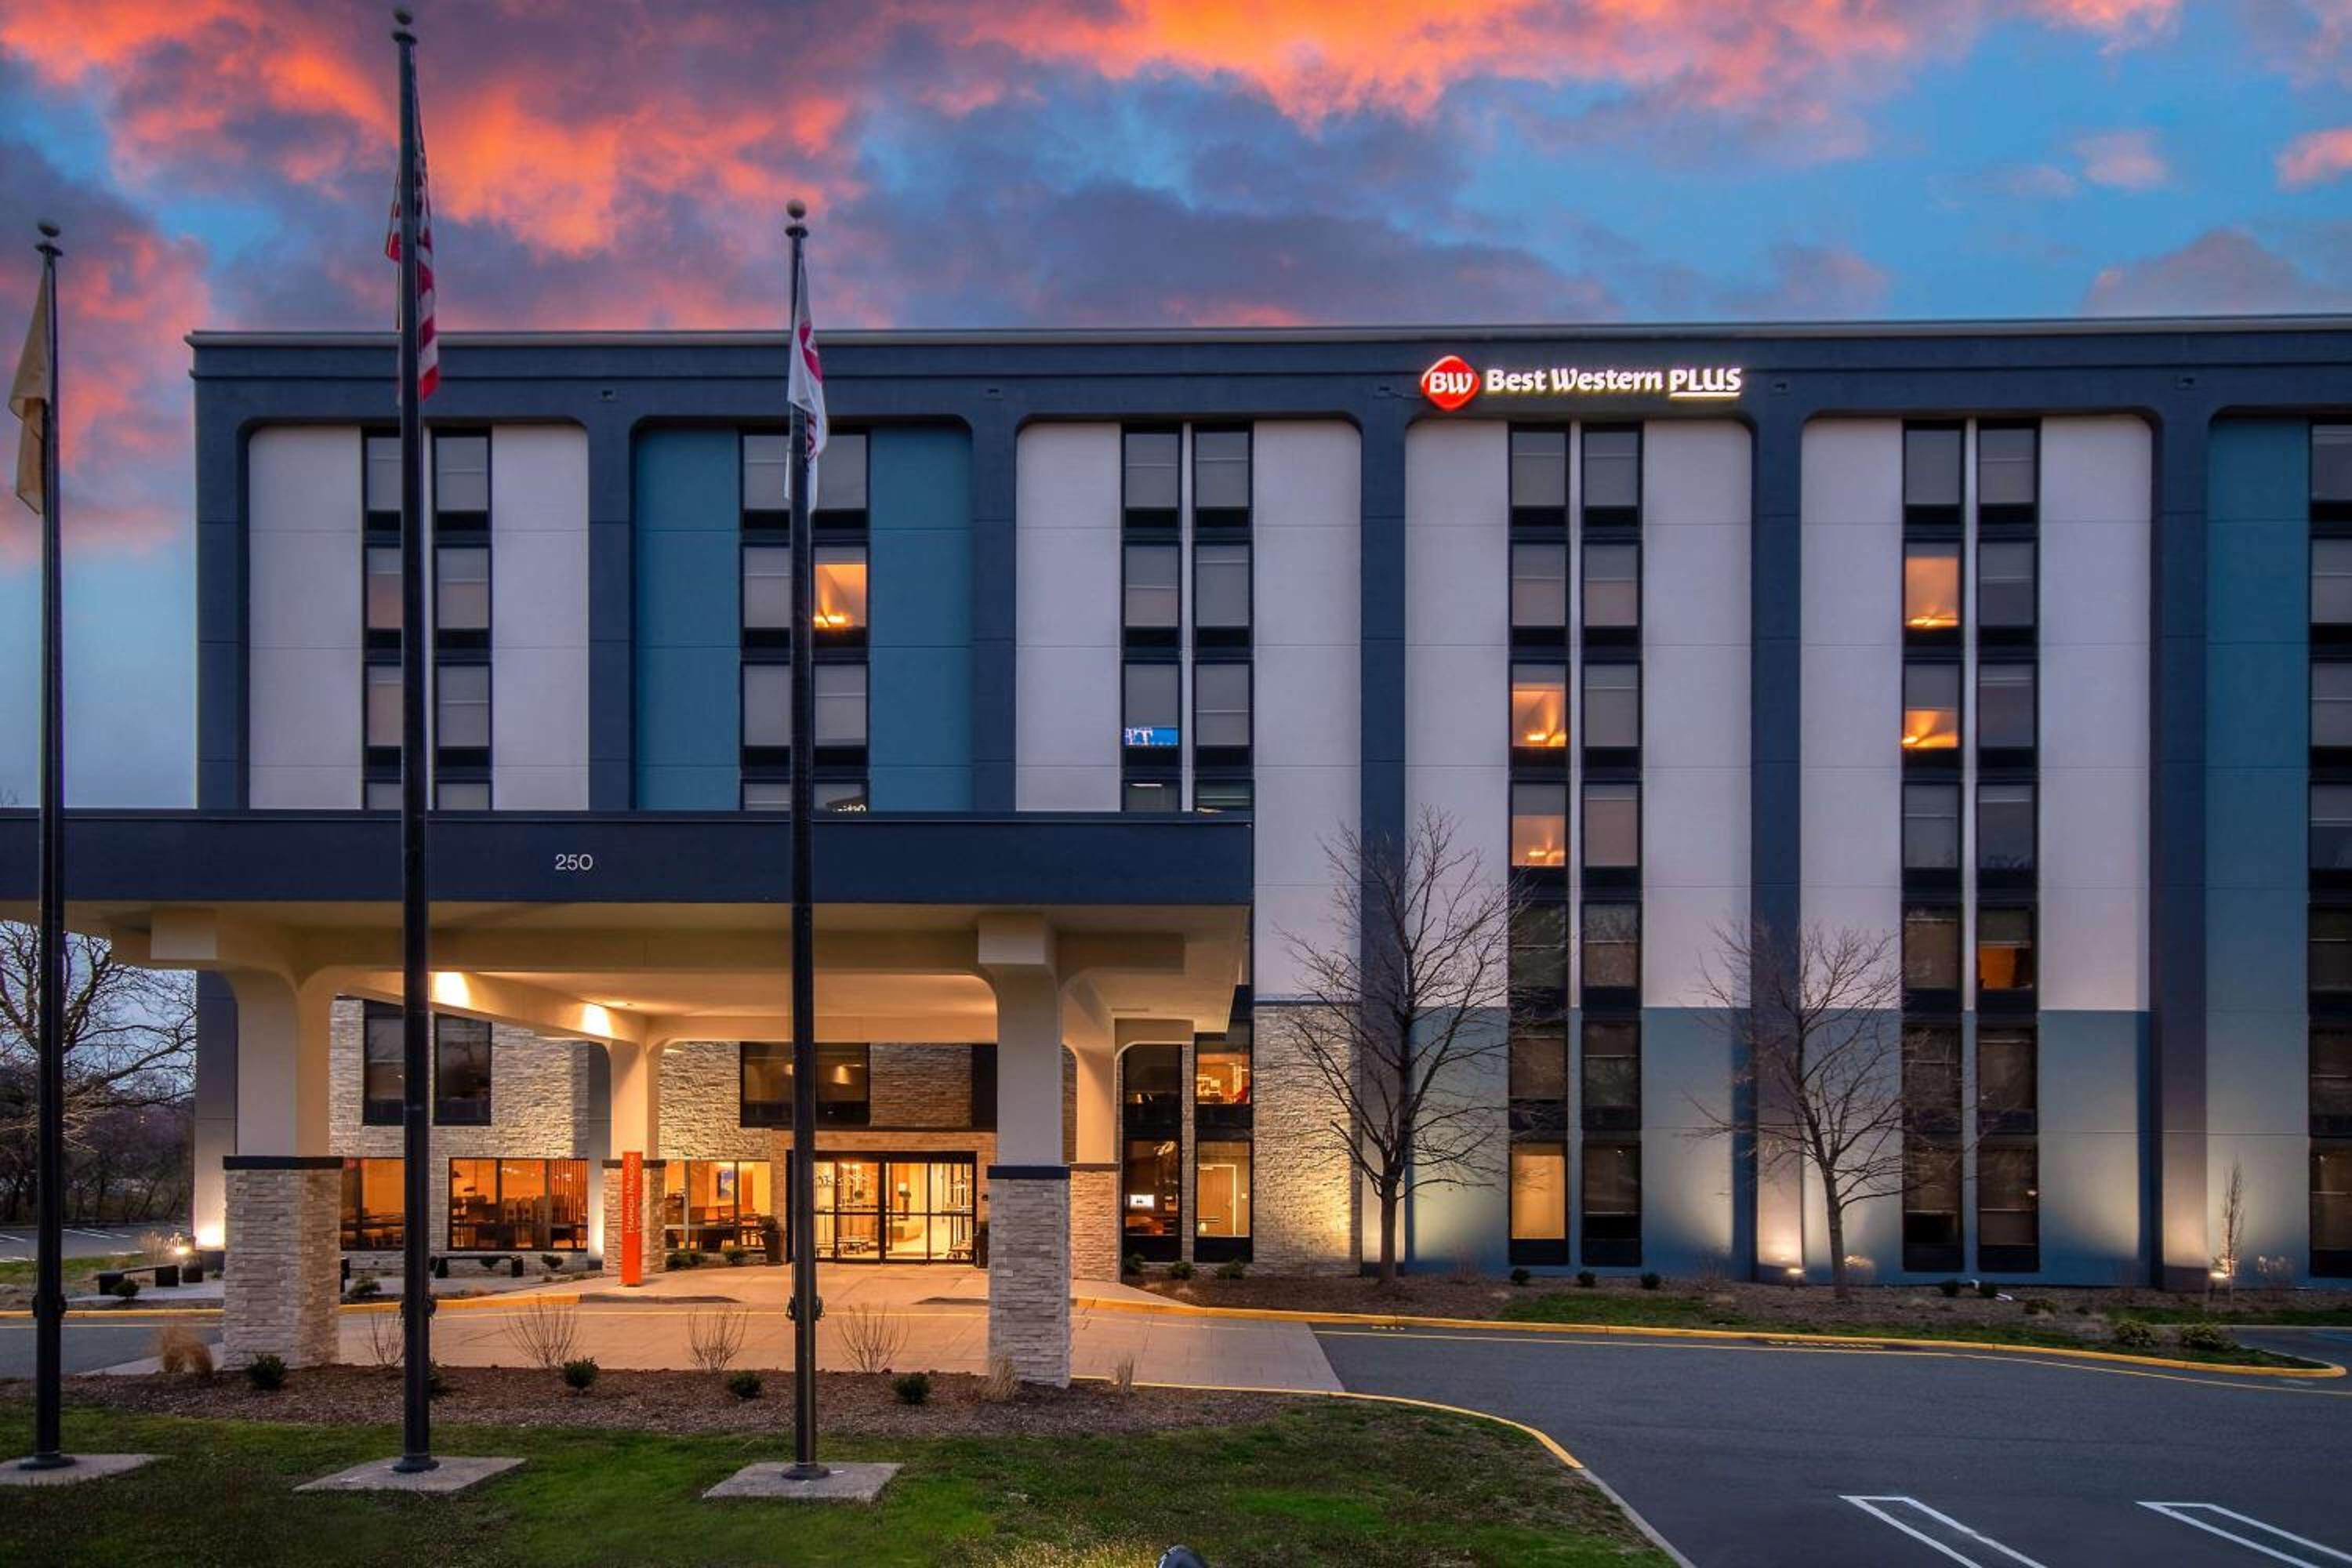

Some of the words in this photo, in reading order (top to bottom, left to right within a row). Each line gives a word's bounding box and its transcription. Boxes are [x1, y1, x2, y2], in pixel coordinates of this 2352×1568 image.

[1429, 372, 1473, 394] BW
[1486, 368, 1547, 392] Best
[1551, 368, 1663, 391] Western
[1669, 368, 1741, 392] PLUS
[555, 854, 593, 871] 250
